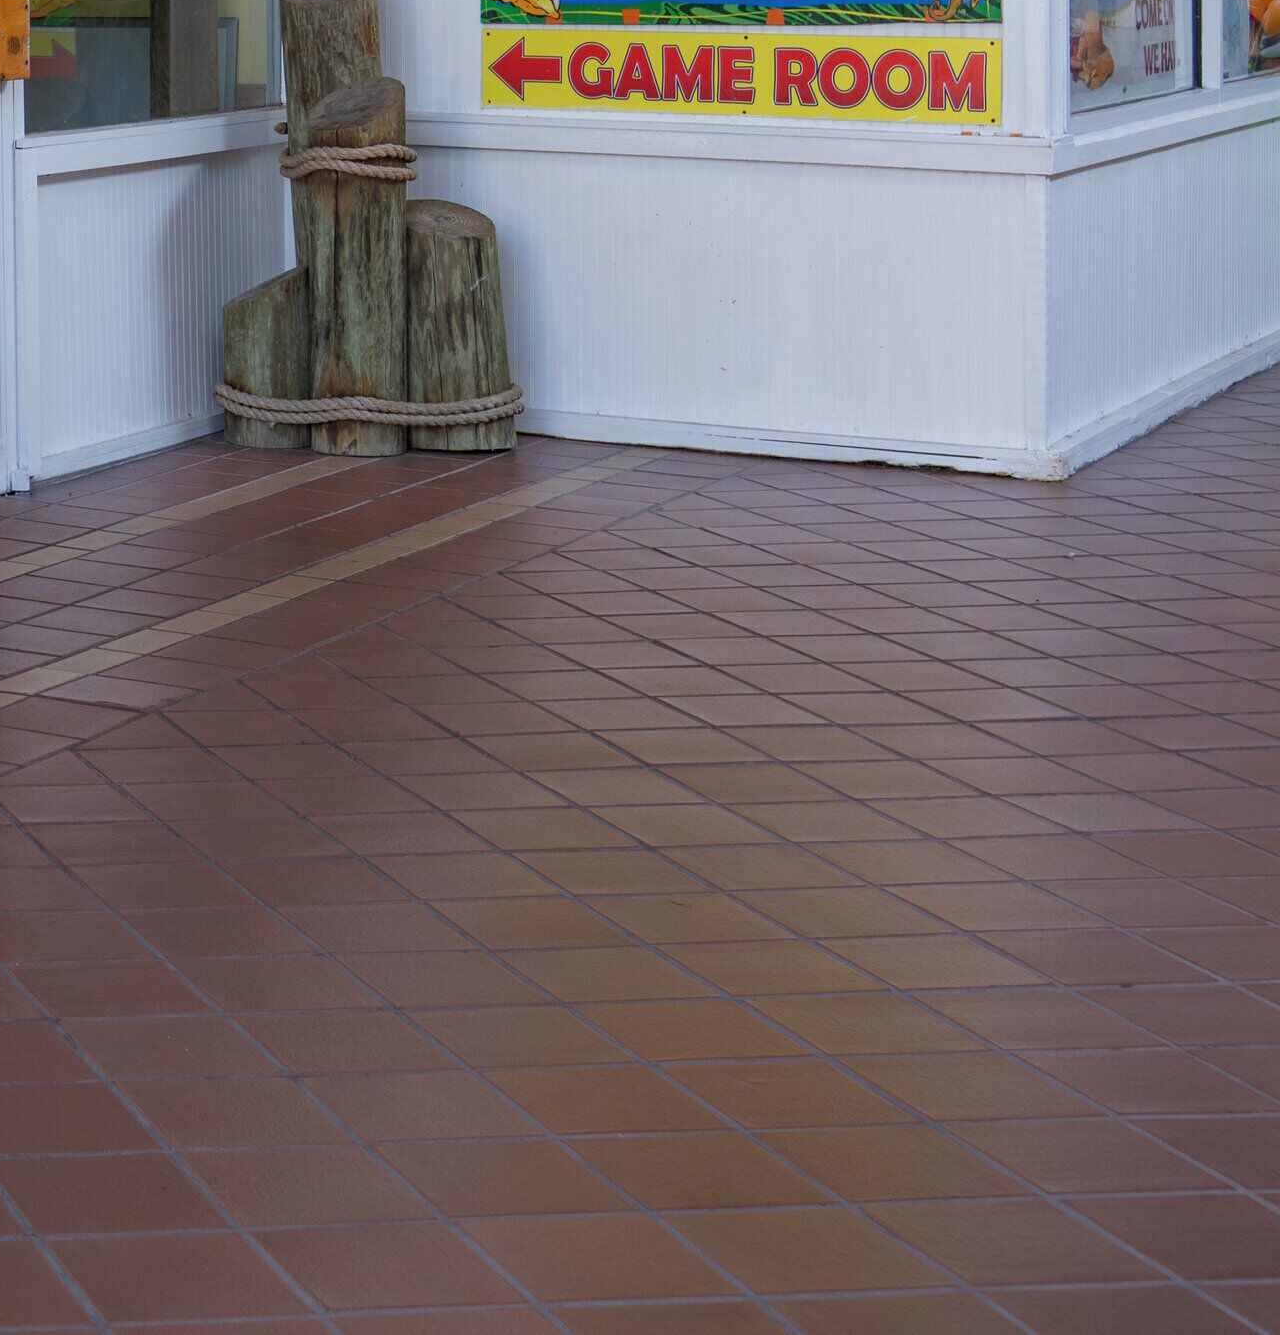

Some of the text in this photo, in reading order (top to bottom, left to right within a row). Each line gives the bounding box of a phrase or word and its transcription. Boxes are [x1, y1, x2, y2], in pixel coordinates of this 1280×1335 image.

[567, 43, 987, 111] GAME ROOM
[1144, 43, 1159, 76] WE
